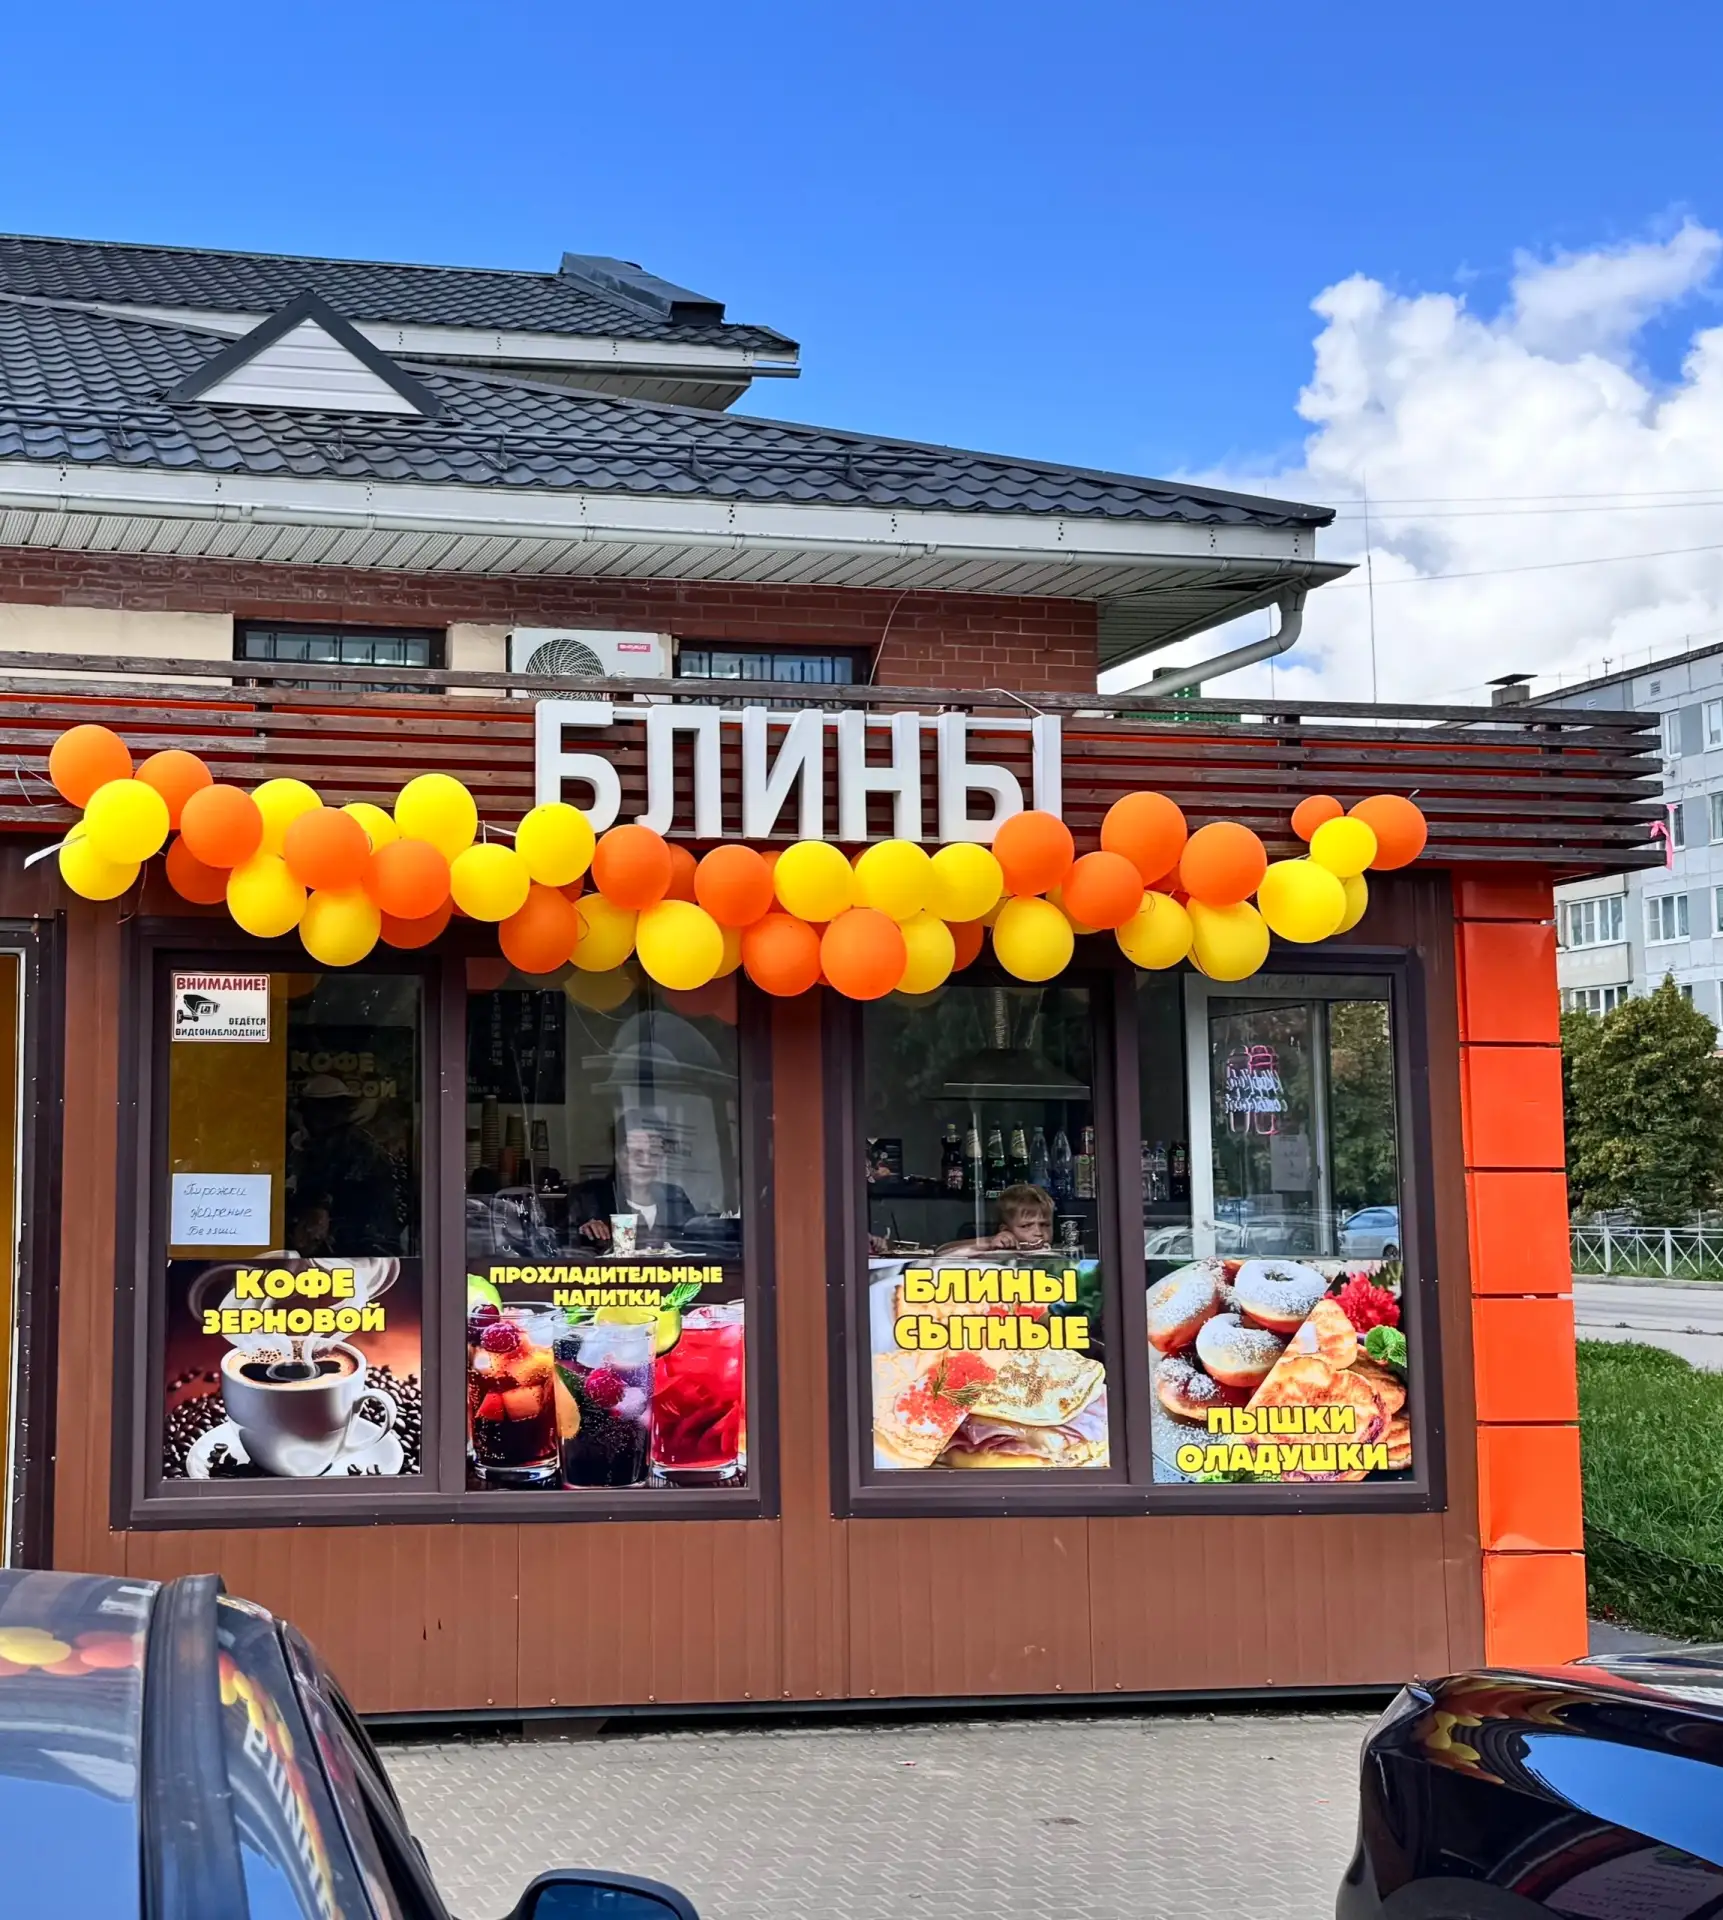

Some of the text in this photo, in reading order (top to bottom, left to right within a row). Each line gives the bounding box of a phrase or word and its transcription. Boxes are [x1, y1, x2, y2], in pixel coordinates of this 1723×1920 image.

[535, 699, 1062, 843] БЛИНЫ
[176, 977, 266, 991] ВНИМАНИЕ!
[175, 1028, 266, 1037] ВИДЕОНАБЛЮДЕНИЕ
[228, 1016, 266, 1026] ВЕДЁТСЯ
[235, 1268, 355, 1299] КОФЕ
[489, 1266, 723, 1285] ПРОХЛАДИТЕЛЬНЫЕ
[904, 1270, 1077, 1303] БЛИНЫ
[553, 1289, 661, 1306] НАПИТКИ
[203, 1303, 385, 1335] ЗЕРНОВОЙ
[895, 1316, 1090, 1350] СЫТНЫЕ
[1206, 1406, 1356, 1434] ПЫШКИ
[1176, 1443, 1389, 1474] ОЛАДУШКИ
